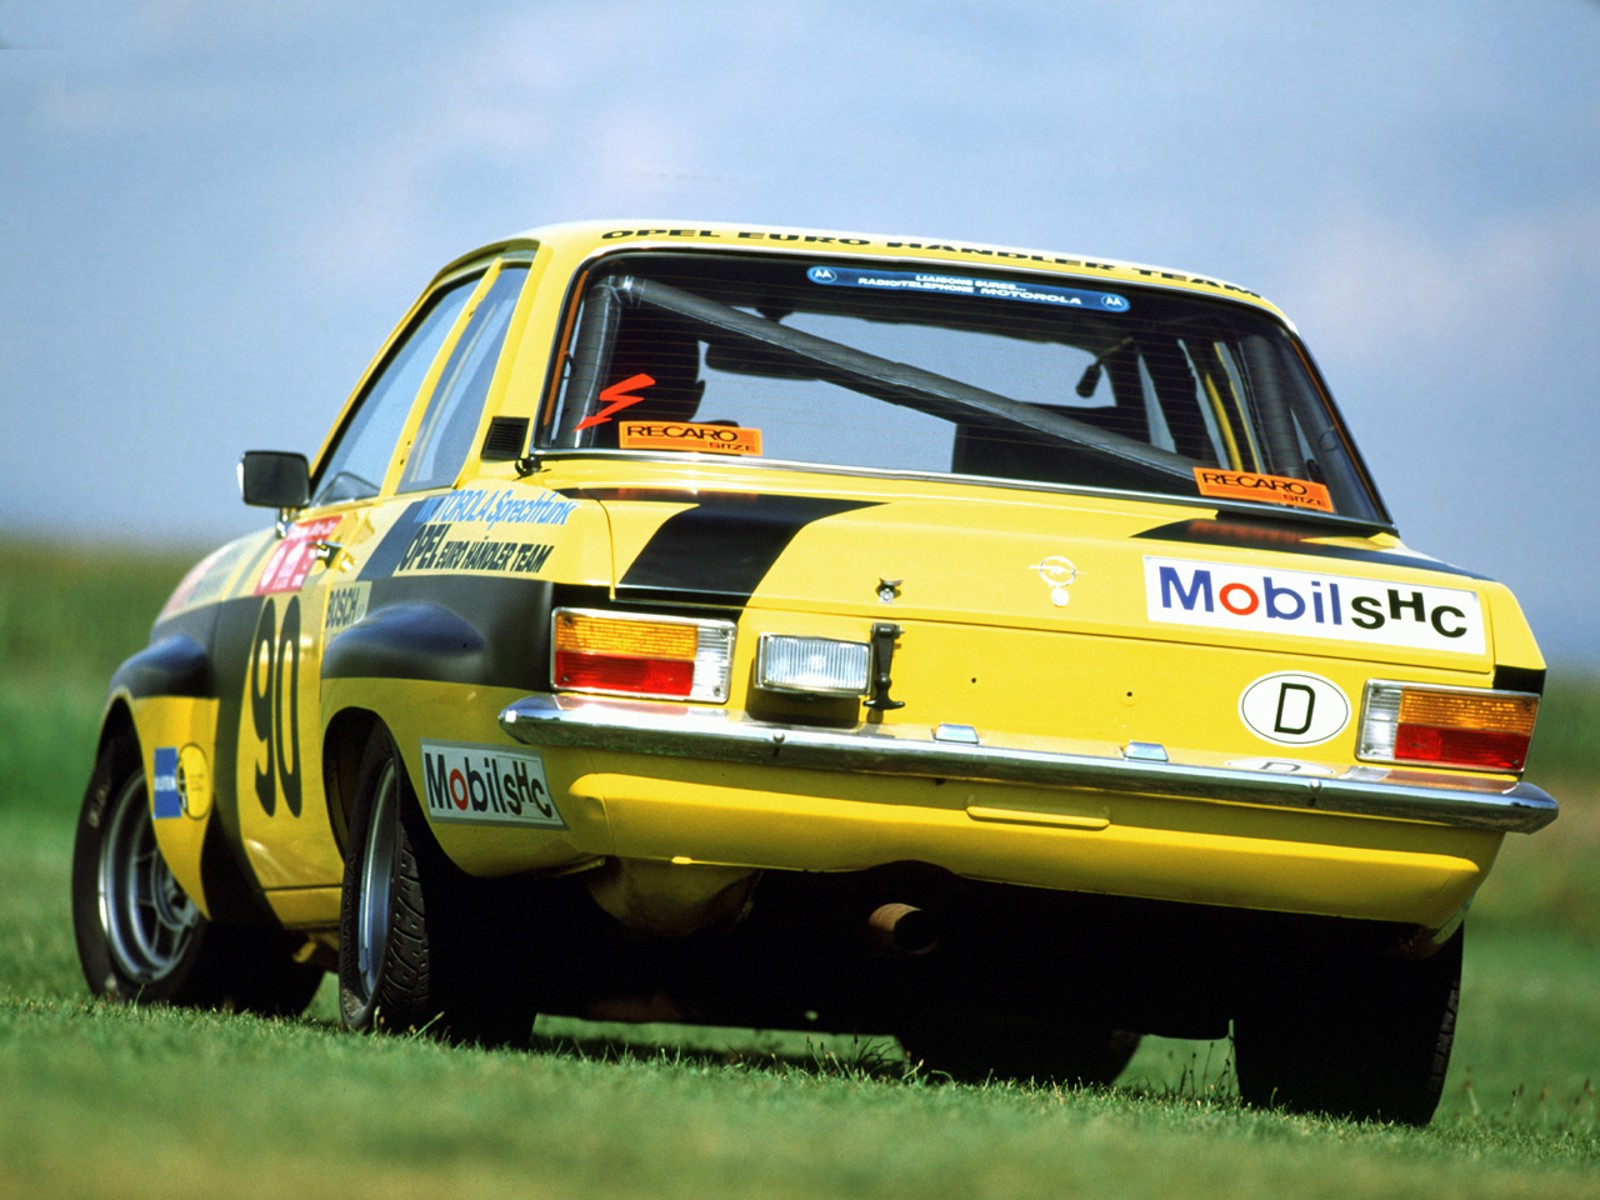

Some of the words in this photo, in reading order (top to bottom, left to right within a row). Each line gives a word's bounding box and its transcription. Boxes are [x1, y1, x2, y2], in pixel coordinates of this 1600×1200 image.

[601, 229, 720, 239] OPEL
[738, 232, 870, 246] EURO
[1132, 268, 1261, 299] TEAM
[915, 274, 973, 286] LIAISONS
[981, 288, 1081, 304] MOTOROLA
[627, 425, 737, 442] RECARO
[1202, 473, 1307, 496] RECARO
[414, 489, 500, 523] MOTOROLA
[486, 489, 579, 531] Sprechfunk
[399, 524, 452, 572] OPEL
[434, 541, 470, 570] EURO
[510, 543, 555, 573] TEAM
[1158, 565, 1343, 626] Mobil
[1351, 588, 1468, 638] SHC
[251, 595, 303, 818] 90
[1274, 682, 1316, 735] D
[424, 752, 508, 814] Mobil
[503, 760, 553, 818] SHC
